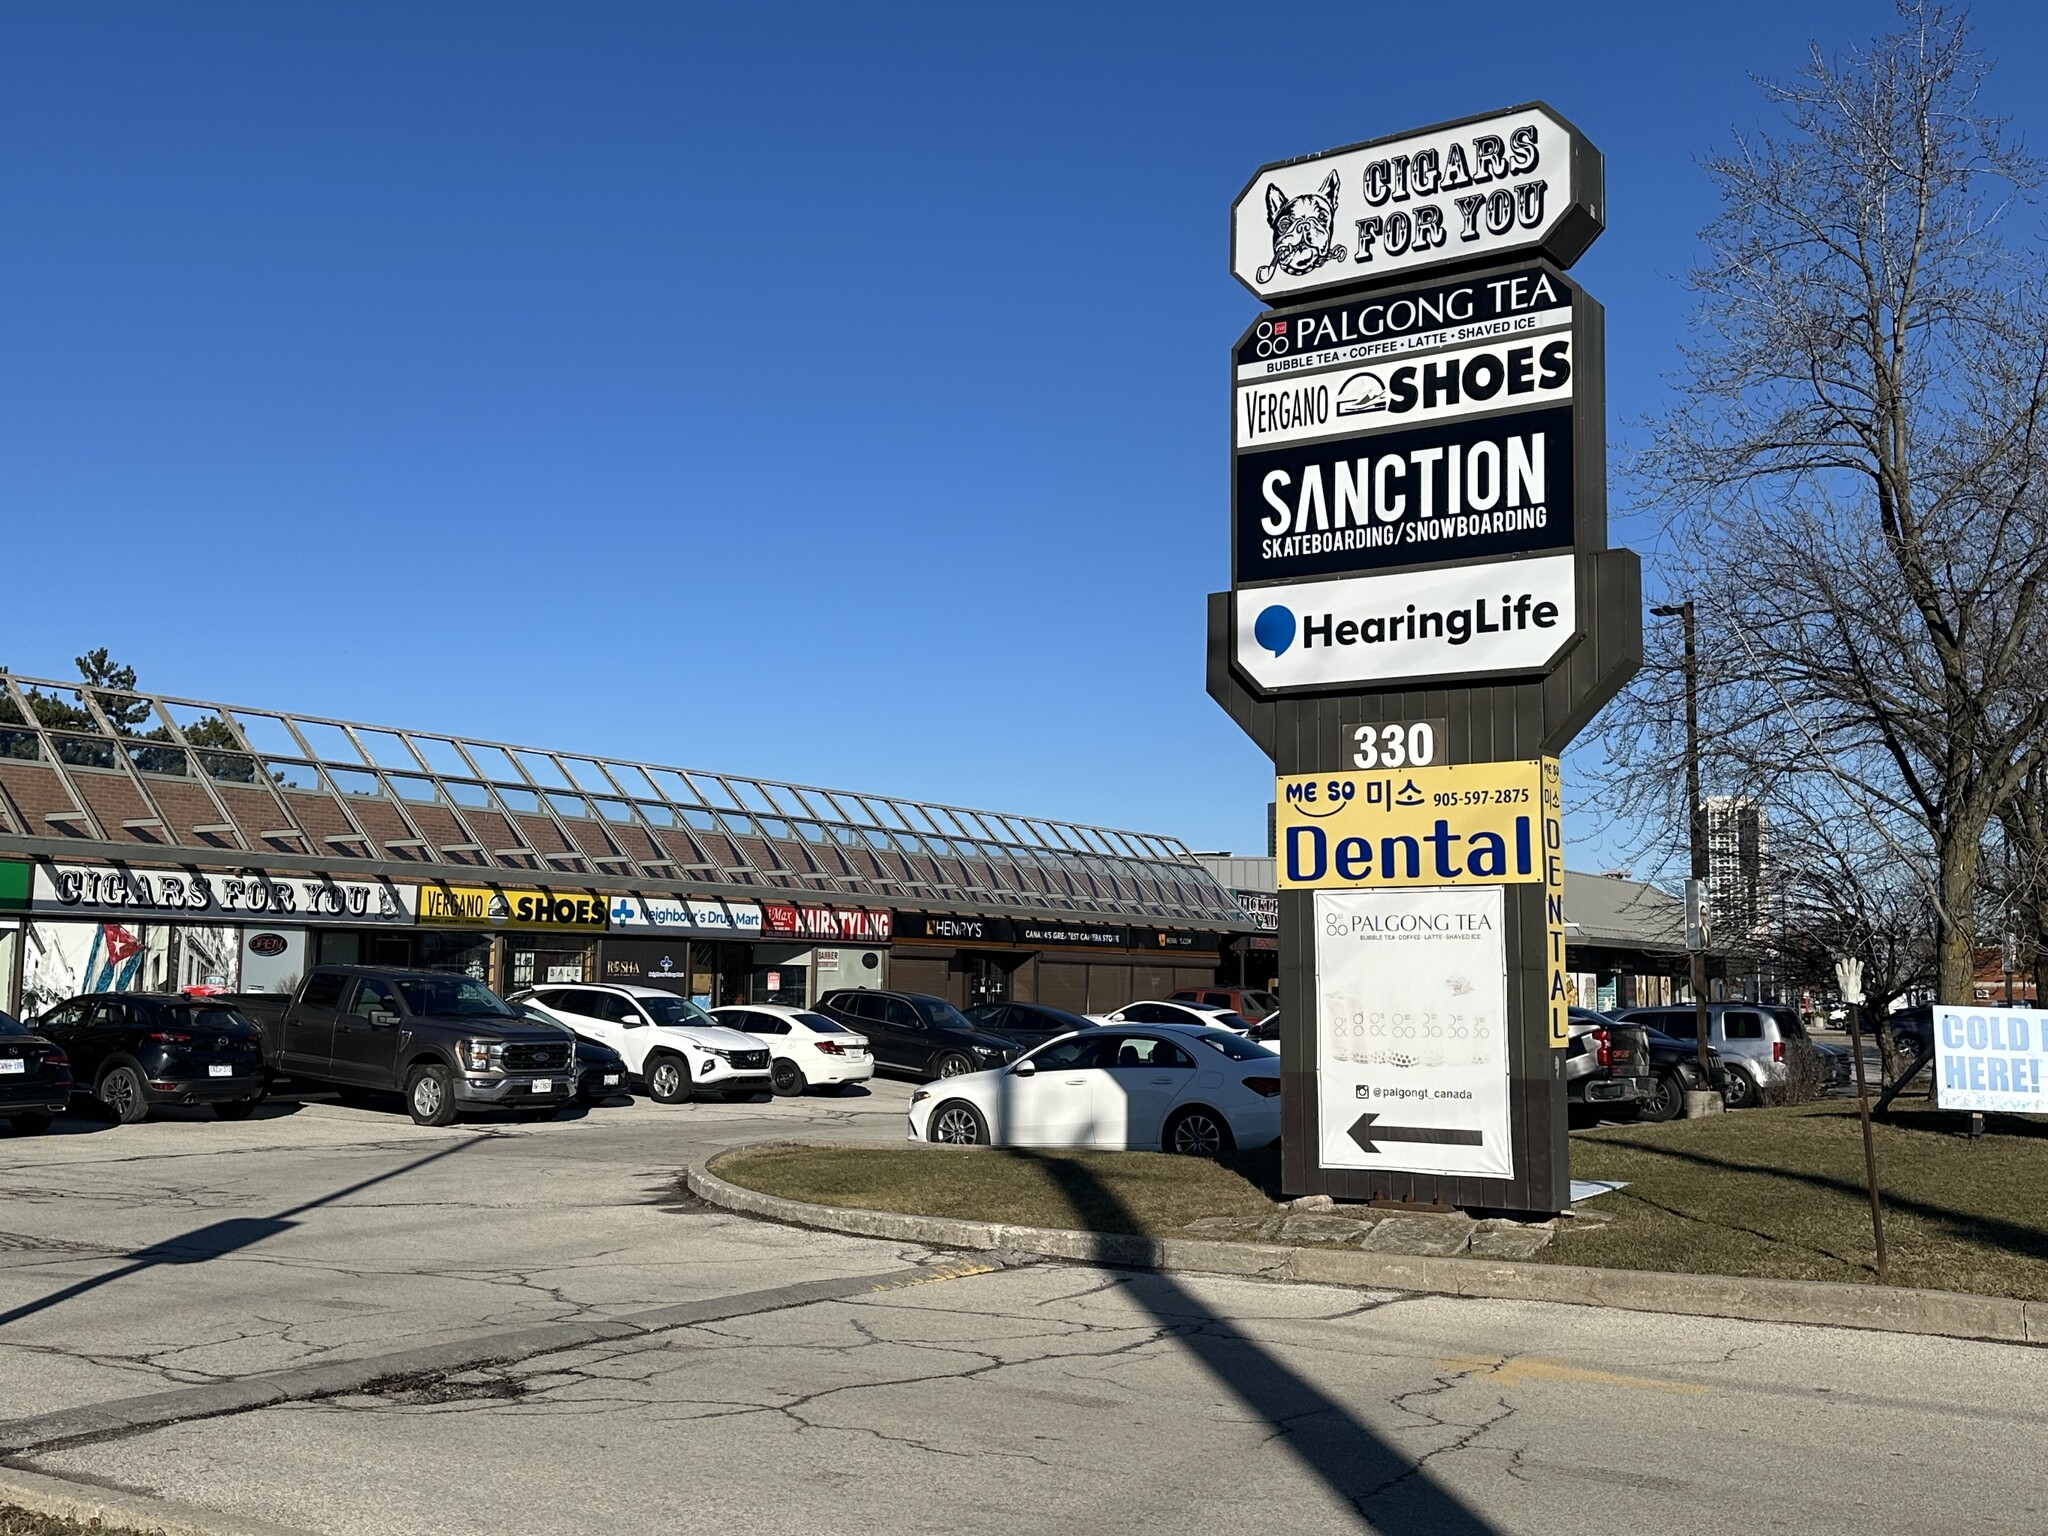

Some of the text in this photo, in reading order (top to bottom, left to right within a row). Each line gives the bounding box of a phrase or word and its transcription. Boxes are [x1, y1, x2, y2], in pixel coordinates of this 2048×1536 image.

[1363, 125, 1540, 207] CIGARS
[1354, 180, 1548, 263] FOR YOU
[1297, 273, 1558, 349] PALGONG TEA
[1266, 316, 1536, 373] BUBBLE TEA COFFEE LATTE SHAVED ICE
[1245, 341, 1571, 439] VERGANO SHOES
[1261, 432, 1545, 537] SANCTION
[1262, 506, 1547, 560] SKATEBOARDING/SNOWBOARDING
[1303, 593, 1559, 649] HearingLife
[1353, 722, 1434, 769] 330
[1286, 780, 1356, 804] ME SO
[1366, 779, 1425, 812] 미소
[1433, 788, 1529, 807] 905-597-2875
[1286, 816, 1532, 881] Dental
[54, 869, 371, 917] CIGARS FOR YOU
[428, 891, 607, 925] VERGANO SHOES
[639, 904, 760, 928] Neighbour's Drug Mart
[795, 908, 889, 941] HAIRSTYLING
[936, 920, 982, 938] HENRY'S
[1352, 914, 1492, 932] PALGONG TEA
[1546, 818, 1567, 1039] DENTAL
[550, 967, 580, 977] SALE
[1942, 1014, 2030, 1051] COLD
[1373, 1087, 1473, 1100] @palgongt_canada
[1944, 1056, 2040, 1093] HERE!
